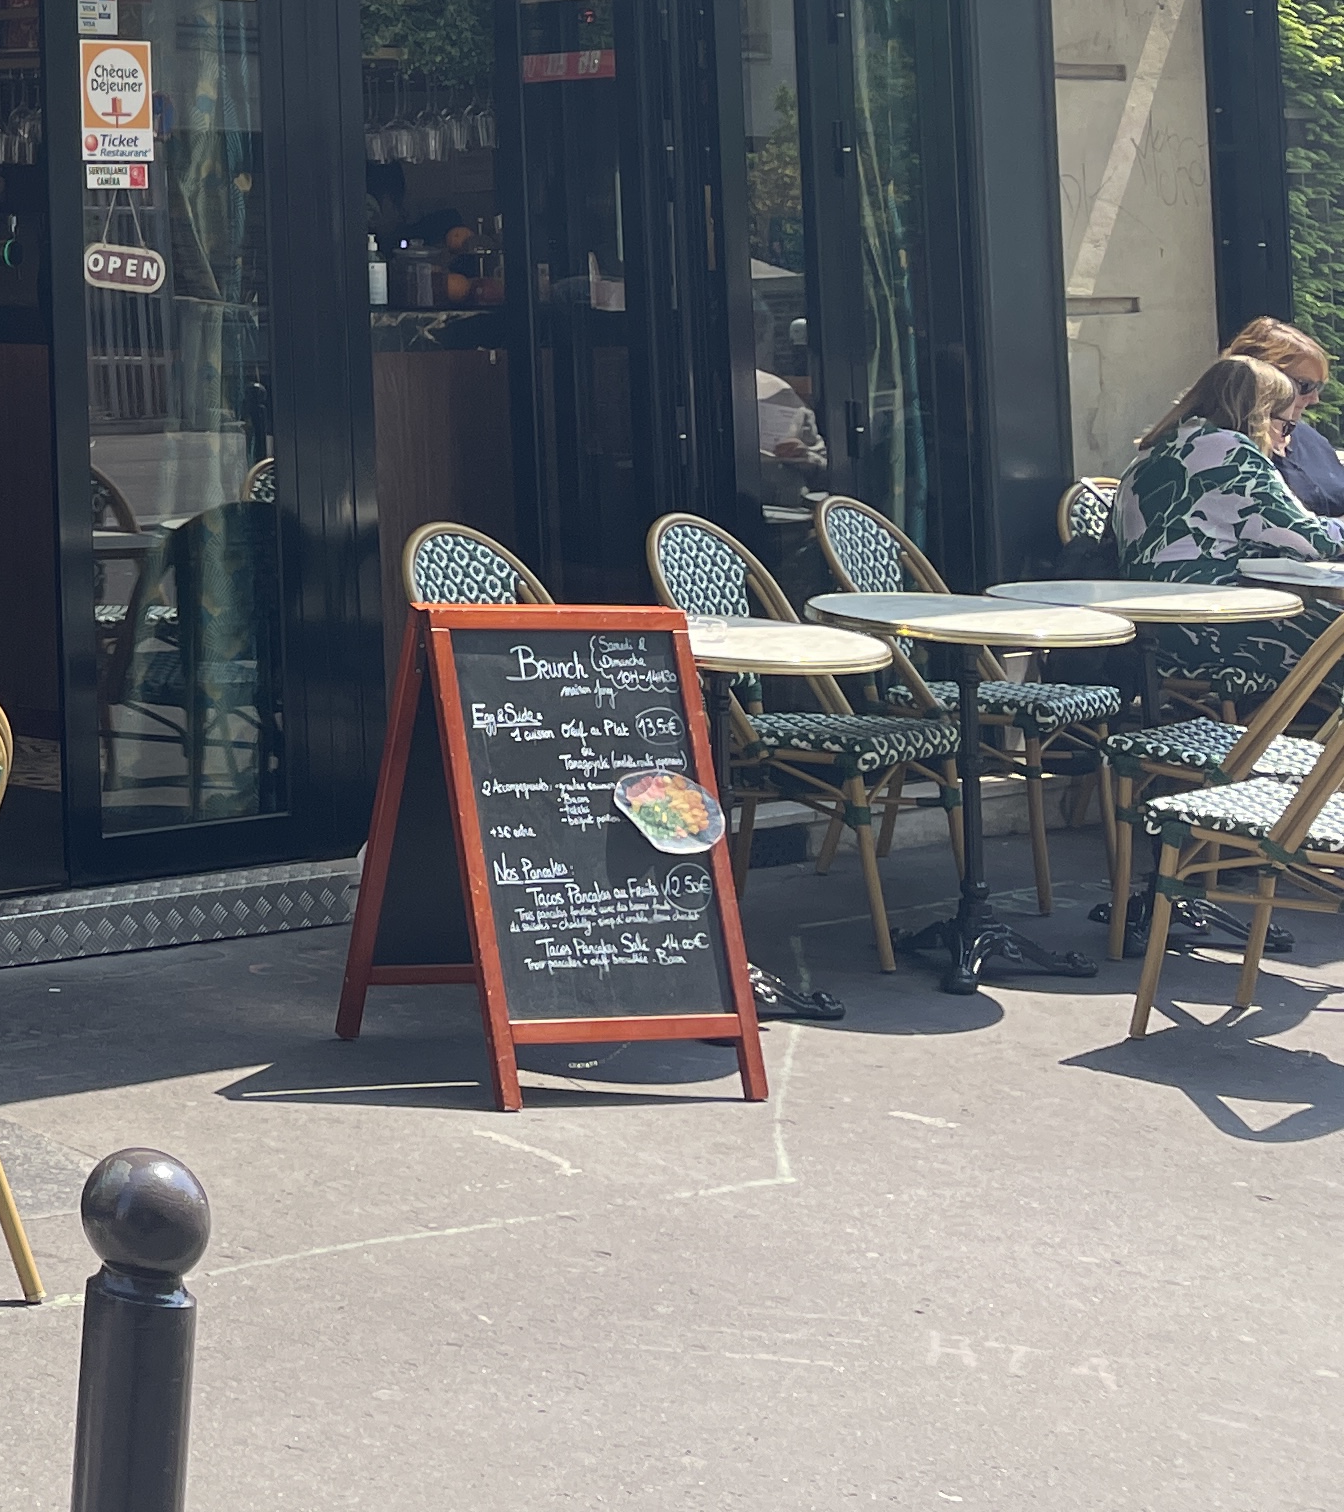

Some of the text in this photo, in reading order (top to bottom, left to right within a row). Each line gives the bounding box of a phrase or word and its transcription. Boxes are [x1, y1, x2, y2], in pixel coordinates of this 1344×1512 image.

[94, 63, 139, 80] Chèque
[91, 77, 143, 95] Déjeuner
[99, 133, 140, 148] Ticket
[87, 253, 159, 281] OPEN
[505, 645, 589, 682] Brunch
[493, 852, 520, 881] Nos
